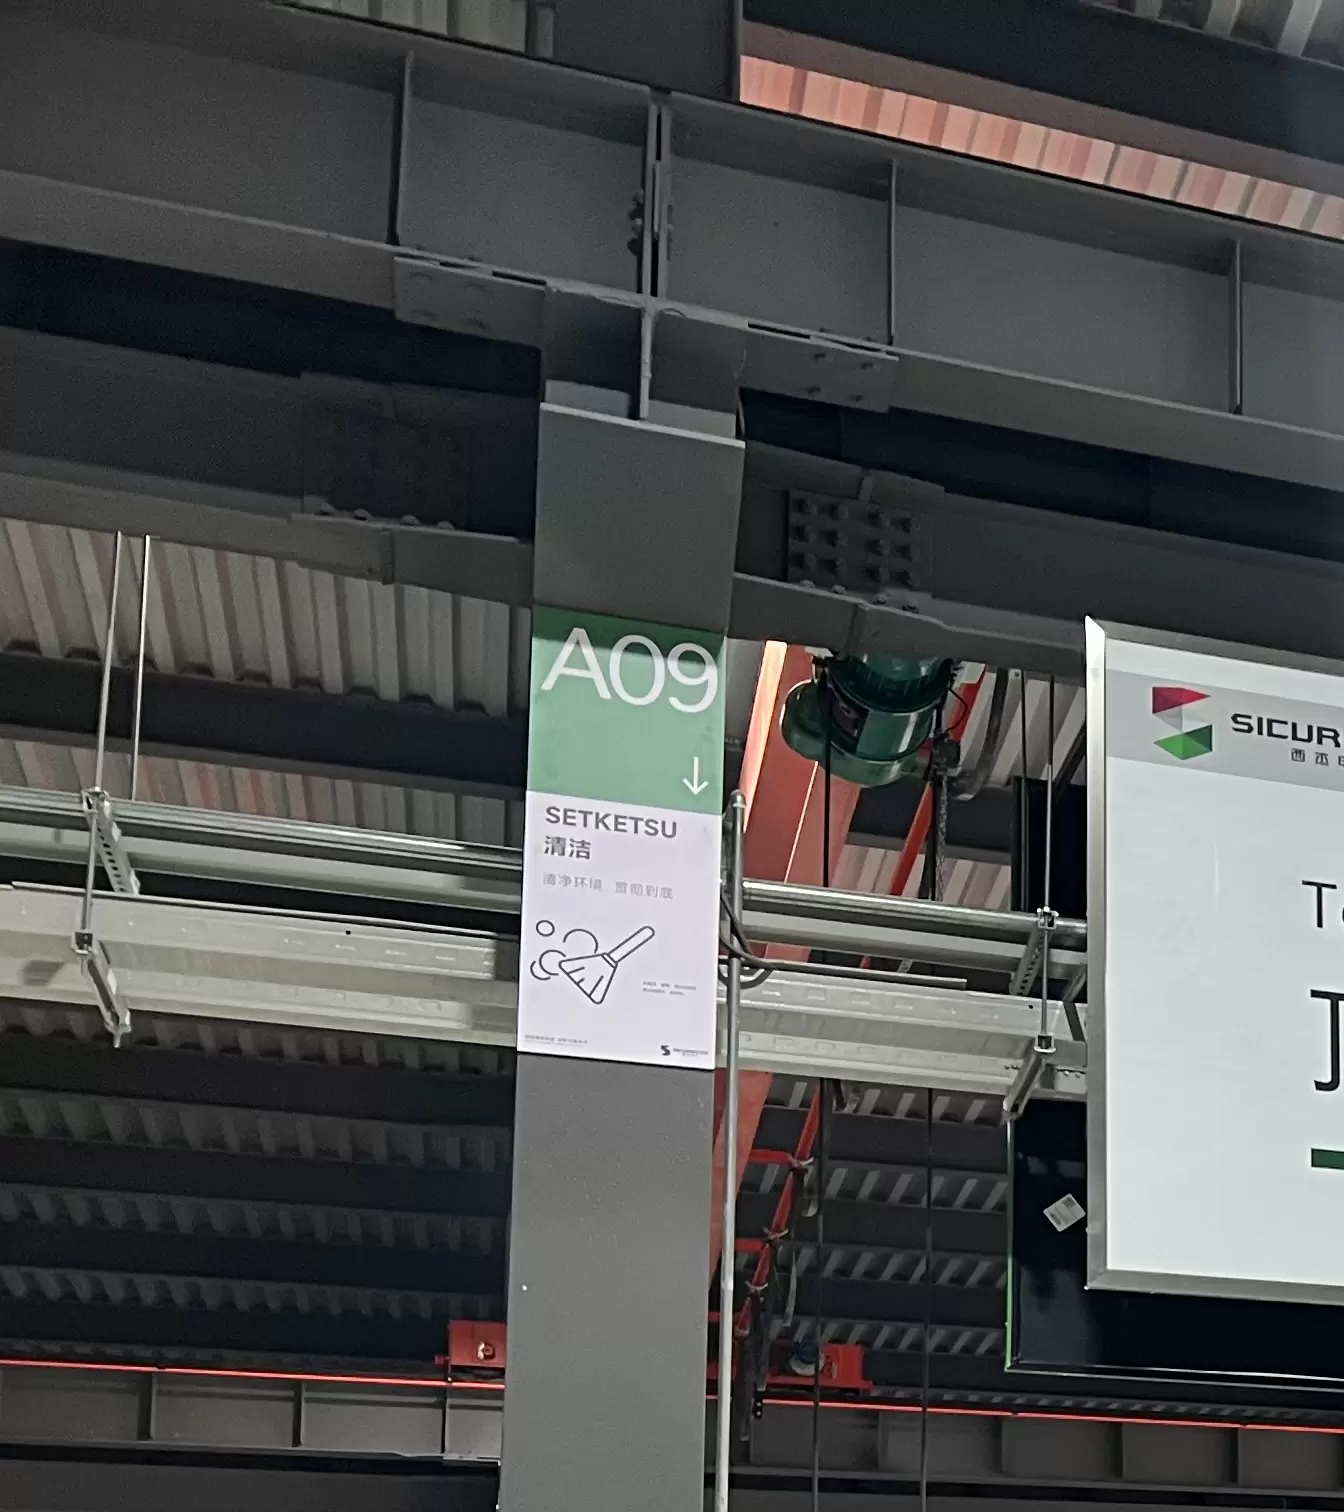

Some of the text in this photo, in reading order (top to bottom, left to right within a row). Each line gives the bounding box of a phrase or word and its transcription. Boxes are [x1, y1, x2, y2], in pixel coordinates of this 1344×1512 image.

[540, 627, 719, 714] A09
[545, 805, 678, 839] SETKETSU
[544, 834, 592, 860] 清洁
